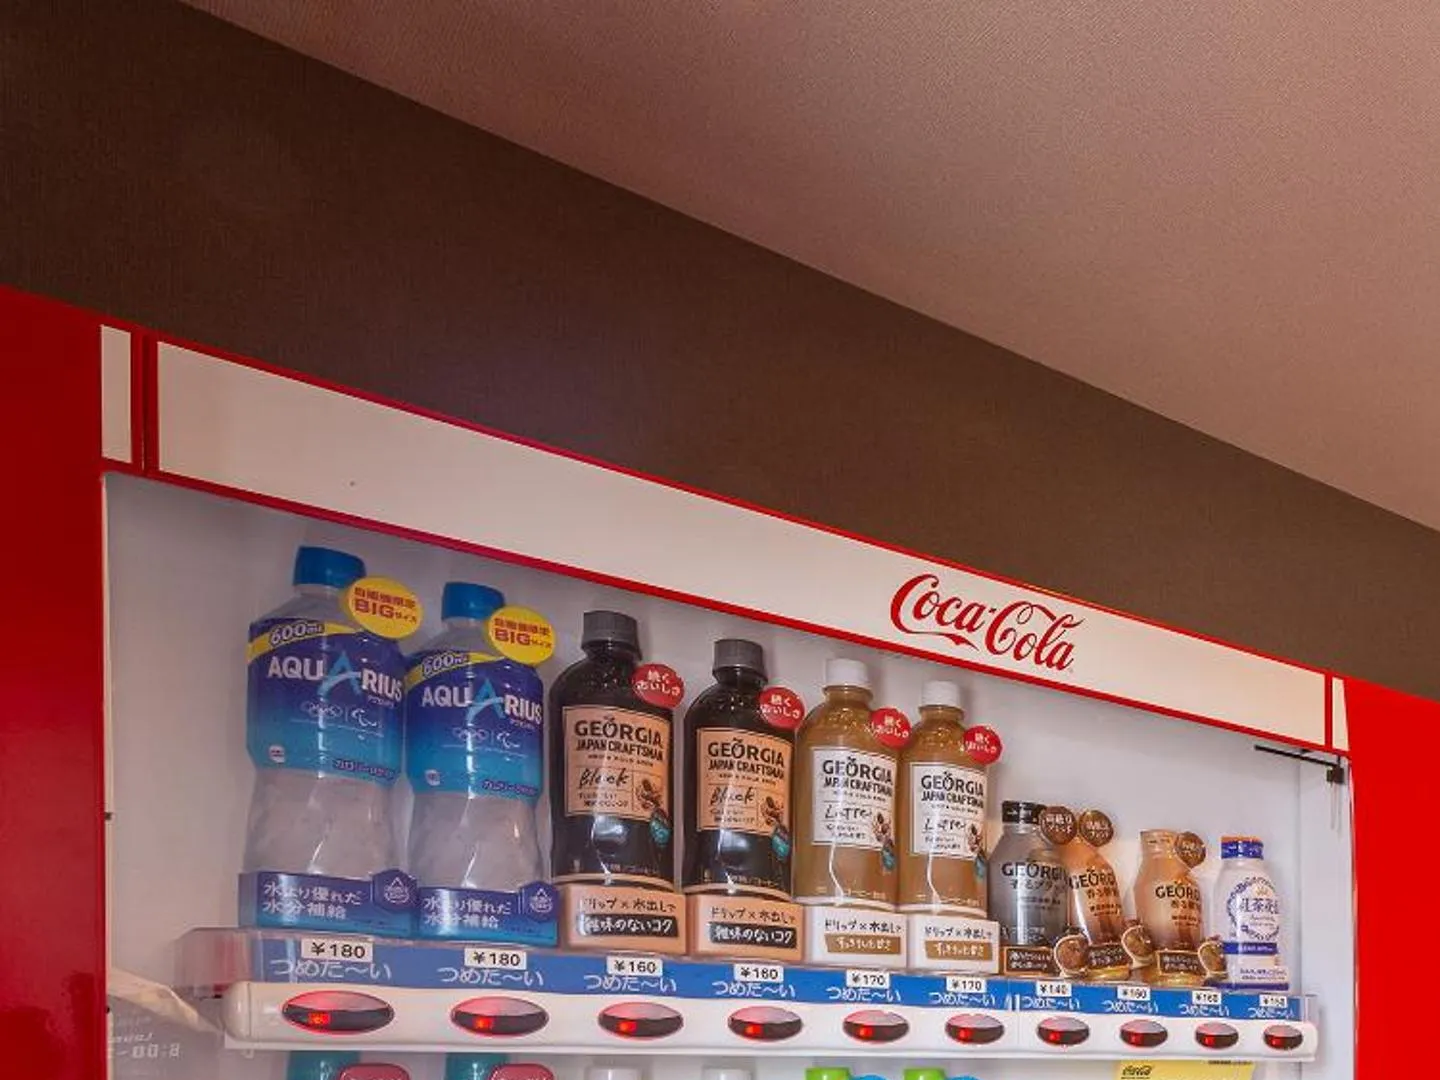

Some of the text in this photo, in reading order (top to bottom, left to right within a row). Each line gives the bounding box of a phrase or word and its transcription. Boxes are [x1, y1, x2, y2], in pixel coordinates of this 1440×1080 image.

[355, 599, 394, 618] BIG
[890, 574, 1084, 671] Coca-Cola
[495, 629, 530, 645] BIG
[267, 651, 403, 702] AQUARIUS
[421, 678, 542, 725] AQUARIUS
[577, 739, 607, 751] JAPAN
[311, 942, 365, 959] ¥180
[473, 952, 520, 967] ¥180
[614, 960, 656, 973] ¥160
